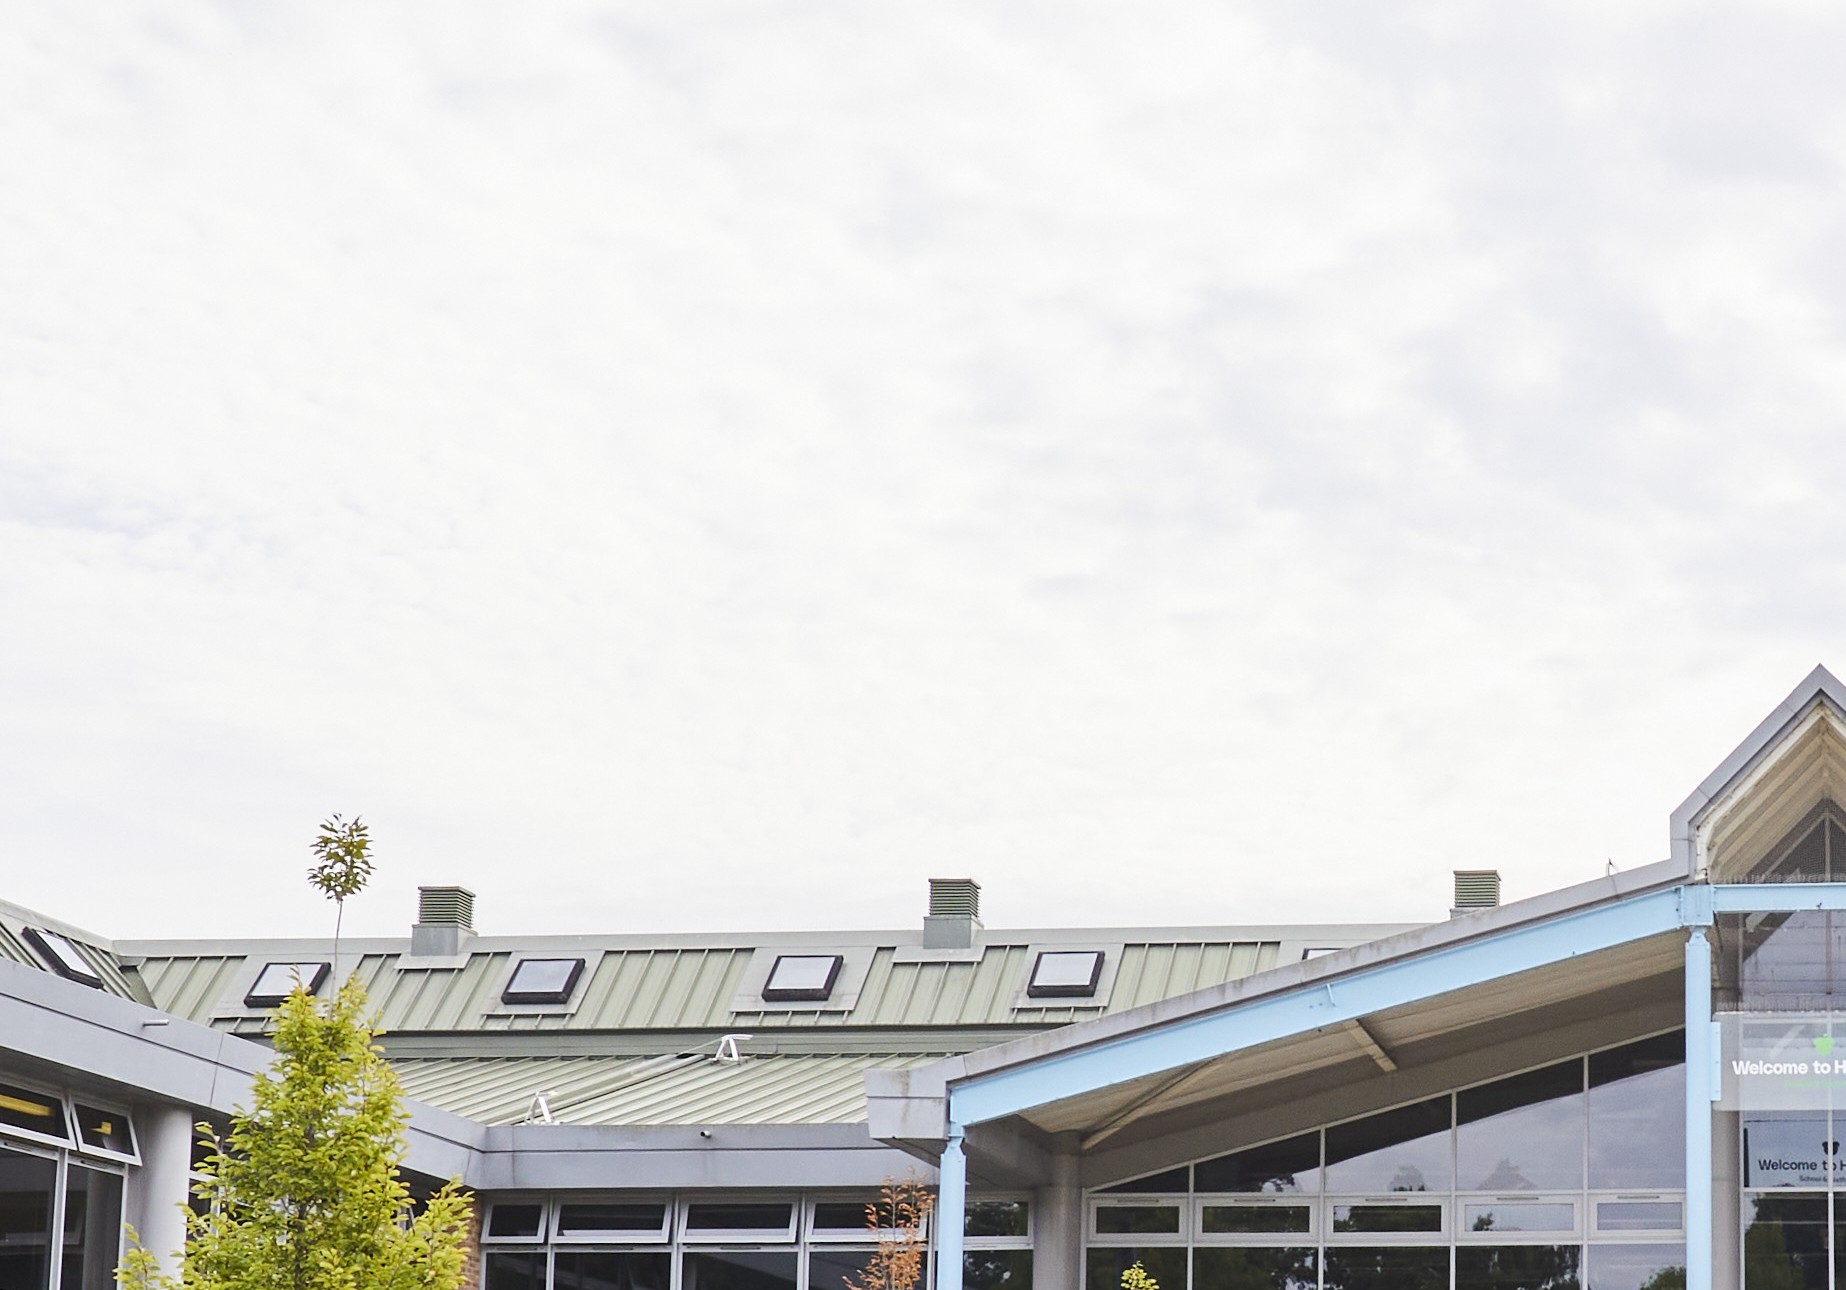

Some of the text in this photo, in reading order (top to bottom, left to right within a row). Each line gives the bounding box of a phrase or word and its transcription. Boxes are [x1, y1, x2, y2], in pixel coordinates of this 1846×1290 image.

[1732, 1060, 1808, 1075] Welcome
[1812, 1060, 1831, 1075] to
[1758, 1159, 1817, 1171] Welcome
